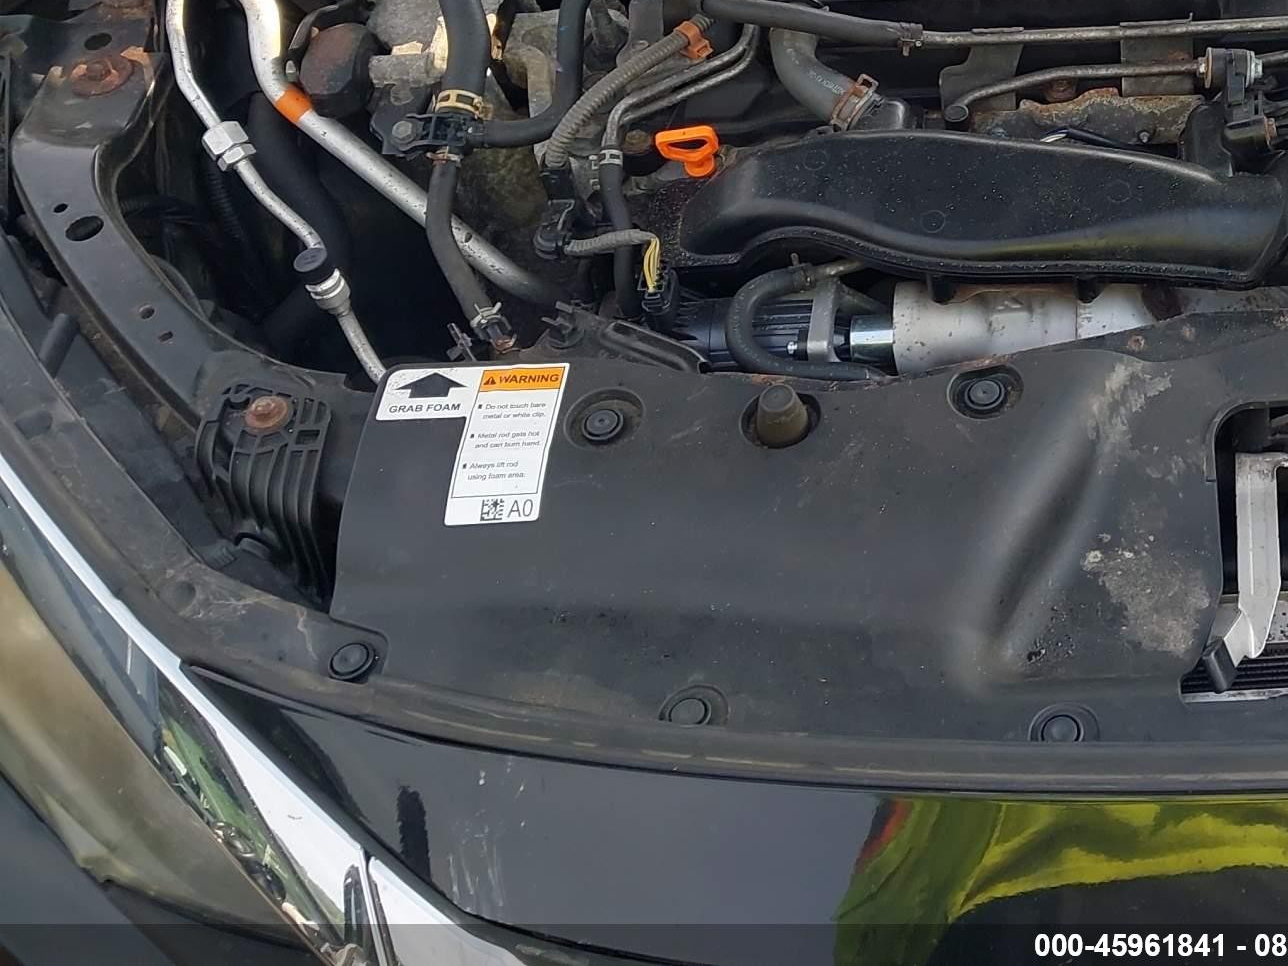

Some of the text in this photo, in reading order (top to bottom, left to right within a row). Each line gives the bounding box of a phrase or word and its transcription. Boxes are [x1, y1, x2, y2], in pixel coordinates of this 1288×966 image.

[499, 373, 559, 384] WARNING
[388, 402, 461, 413] GRAB FOAM
[532, 411, 546, 419] clip.
[469, 462, 495, 470] Always
[506, 460, 519, 468] rod
[488, 472, 506, 480] foam
[507, 498, 534, 518] A0
